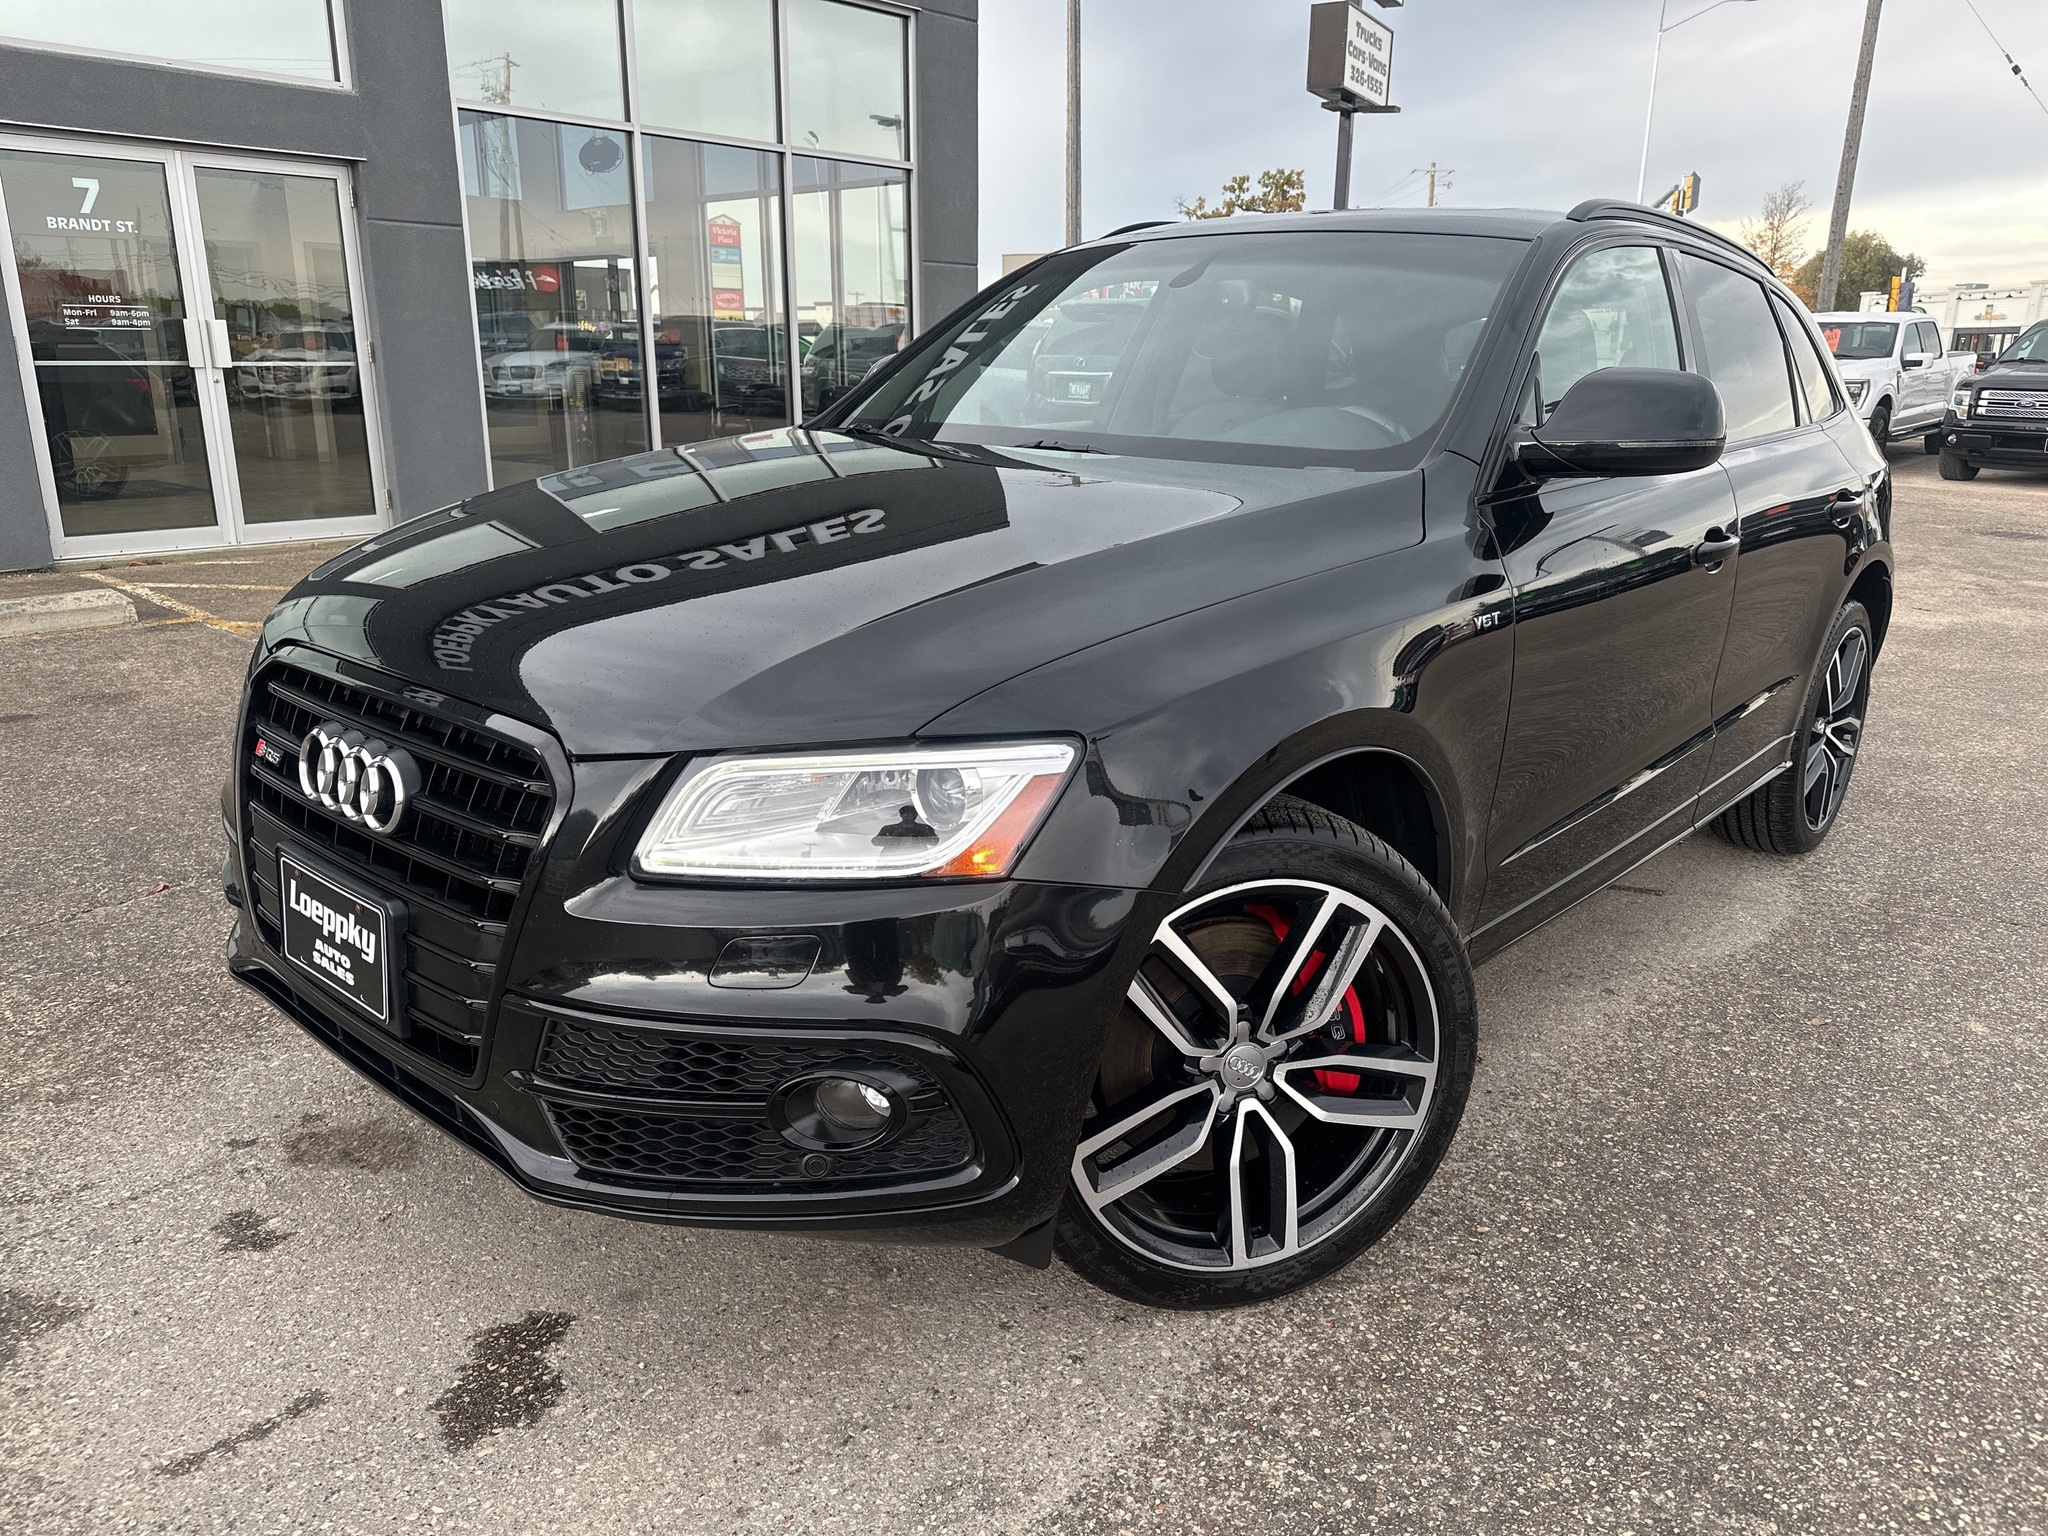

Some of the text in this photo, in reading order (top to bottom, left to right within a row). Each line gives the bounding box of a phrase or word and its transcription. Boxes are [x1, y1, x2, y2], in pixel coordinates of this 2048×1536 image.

[1355, 20, 1383, 52] Trucks
[1350, 64, 1383, 97] 326-1555
[71, 177, 100, 214] 7
[46, 216, 138, 233] BRANDT ST.
[63, 308, 150, 318] Mon-Fri 9am-6pm
[88, 294, 121, 304] HOURS
[64, 317, 151, 327] Sat 9am-4pm
[1473, 611, 1501, 630] V6T
[289, 878, 376, 964] Loeppky
[312, 950, 355, 986] SALES
[314, 938, 351, 969] AUTO
